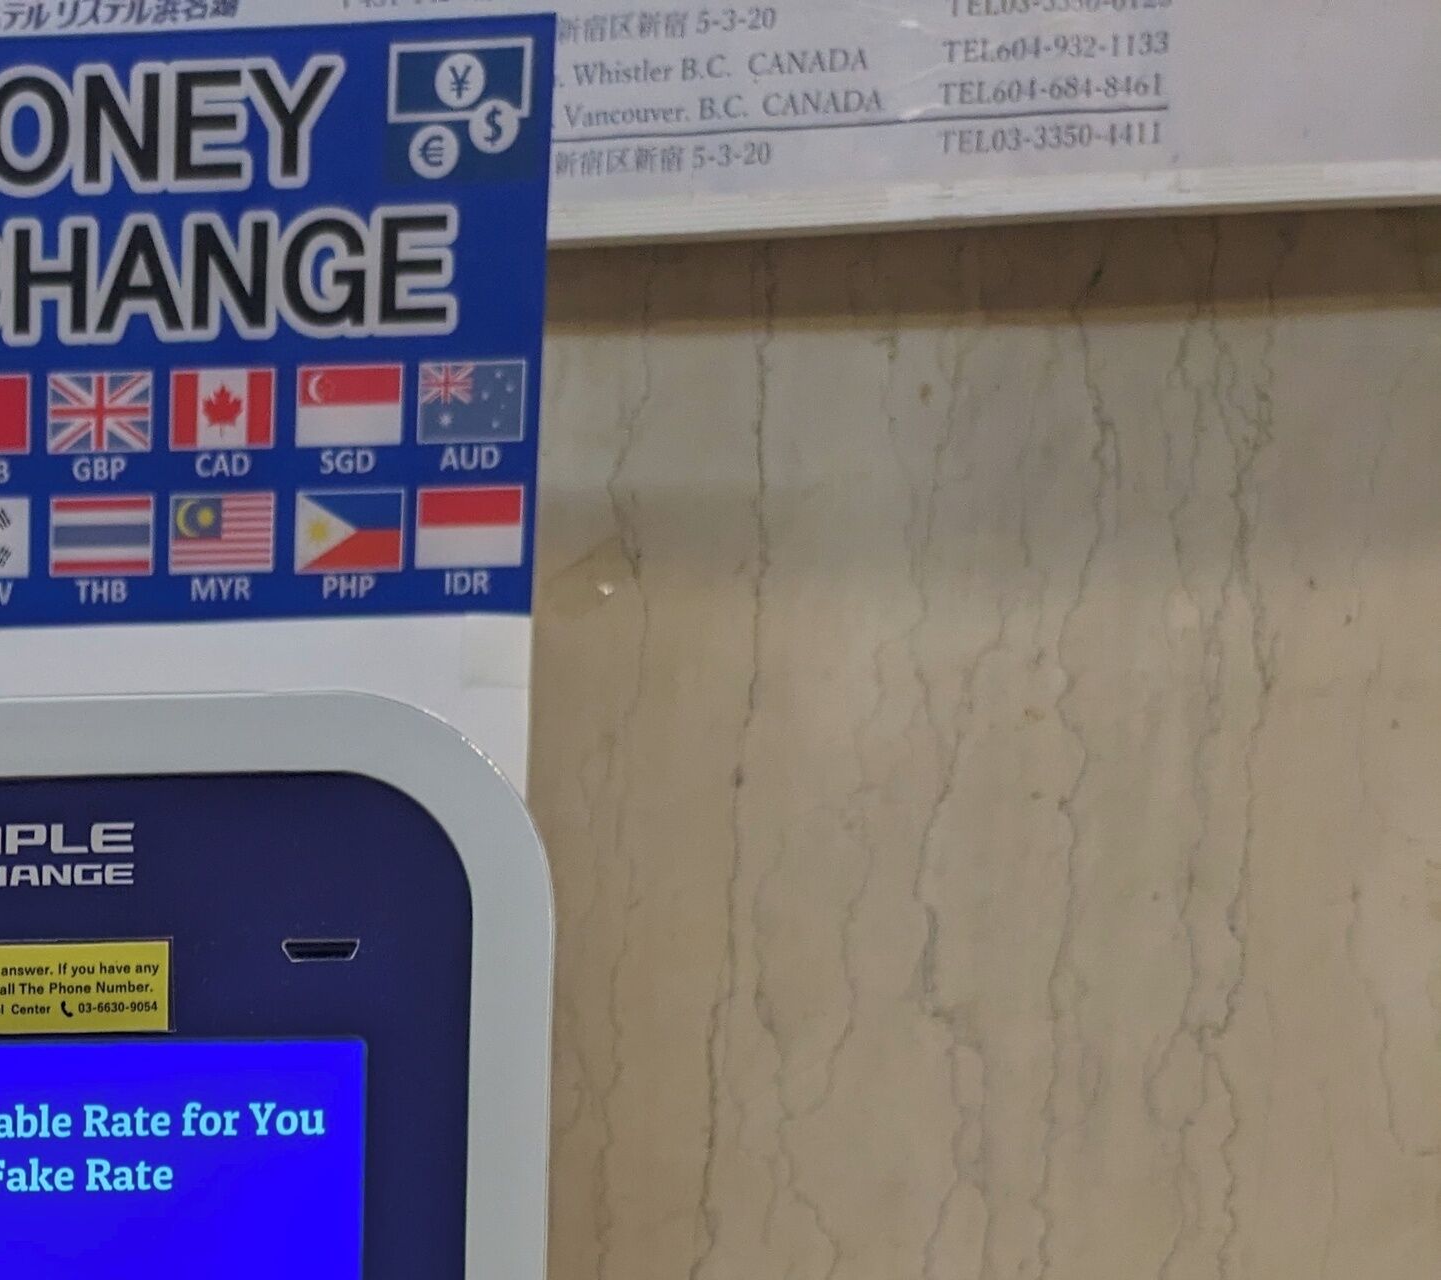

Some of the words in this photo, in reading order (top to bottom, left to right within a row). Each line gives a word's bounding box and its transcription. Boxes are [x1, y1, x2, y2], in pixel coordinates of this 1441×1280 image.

[695, 7, 777, 35] 5-3-20
[573, 59, 673, 87] Whistler
[680, 54, 732, 81] B.C.
[748, 48, 869, 77] CANADA
[698, 96, 749, 121] B.C.
[762, 89, 883, 118] CANADA
[692, 141, 772, 169] 5-3-20
[71, 457, 126, 482] GBP
[195, 452, 252, 477] CAD
[319, 449, 376, 475] SGD
[439, 446, 501, 471] AUD
[75, 579, 127, 605] THB
[190, 576, 252, 602] MYR
[322, 575, 377, 600] PHP
[444, 570, 491, 596] IDR
[0, 966, 54, 976] answer.
[58, 962, 67, 974] If
[71, 964, 95, 977] you
[99, 962, 131, 974] have
[135, 963, 160, 976] any
[19, 983, 44, 995] The
[49, 982, 91, 994] Phone
[96, 981, 154, 993] Number.
[10, 1004, 51, 1015] Center
[78, 1001, 158, 1013] 03-6630-9054
[83, 1103, 172, 1137] Rate
[181, 1101, 239, 1136] for
[248, 1100, 327, 1136] You
[85, 1158, 175, 1193] Rate
